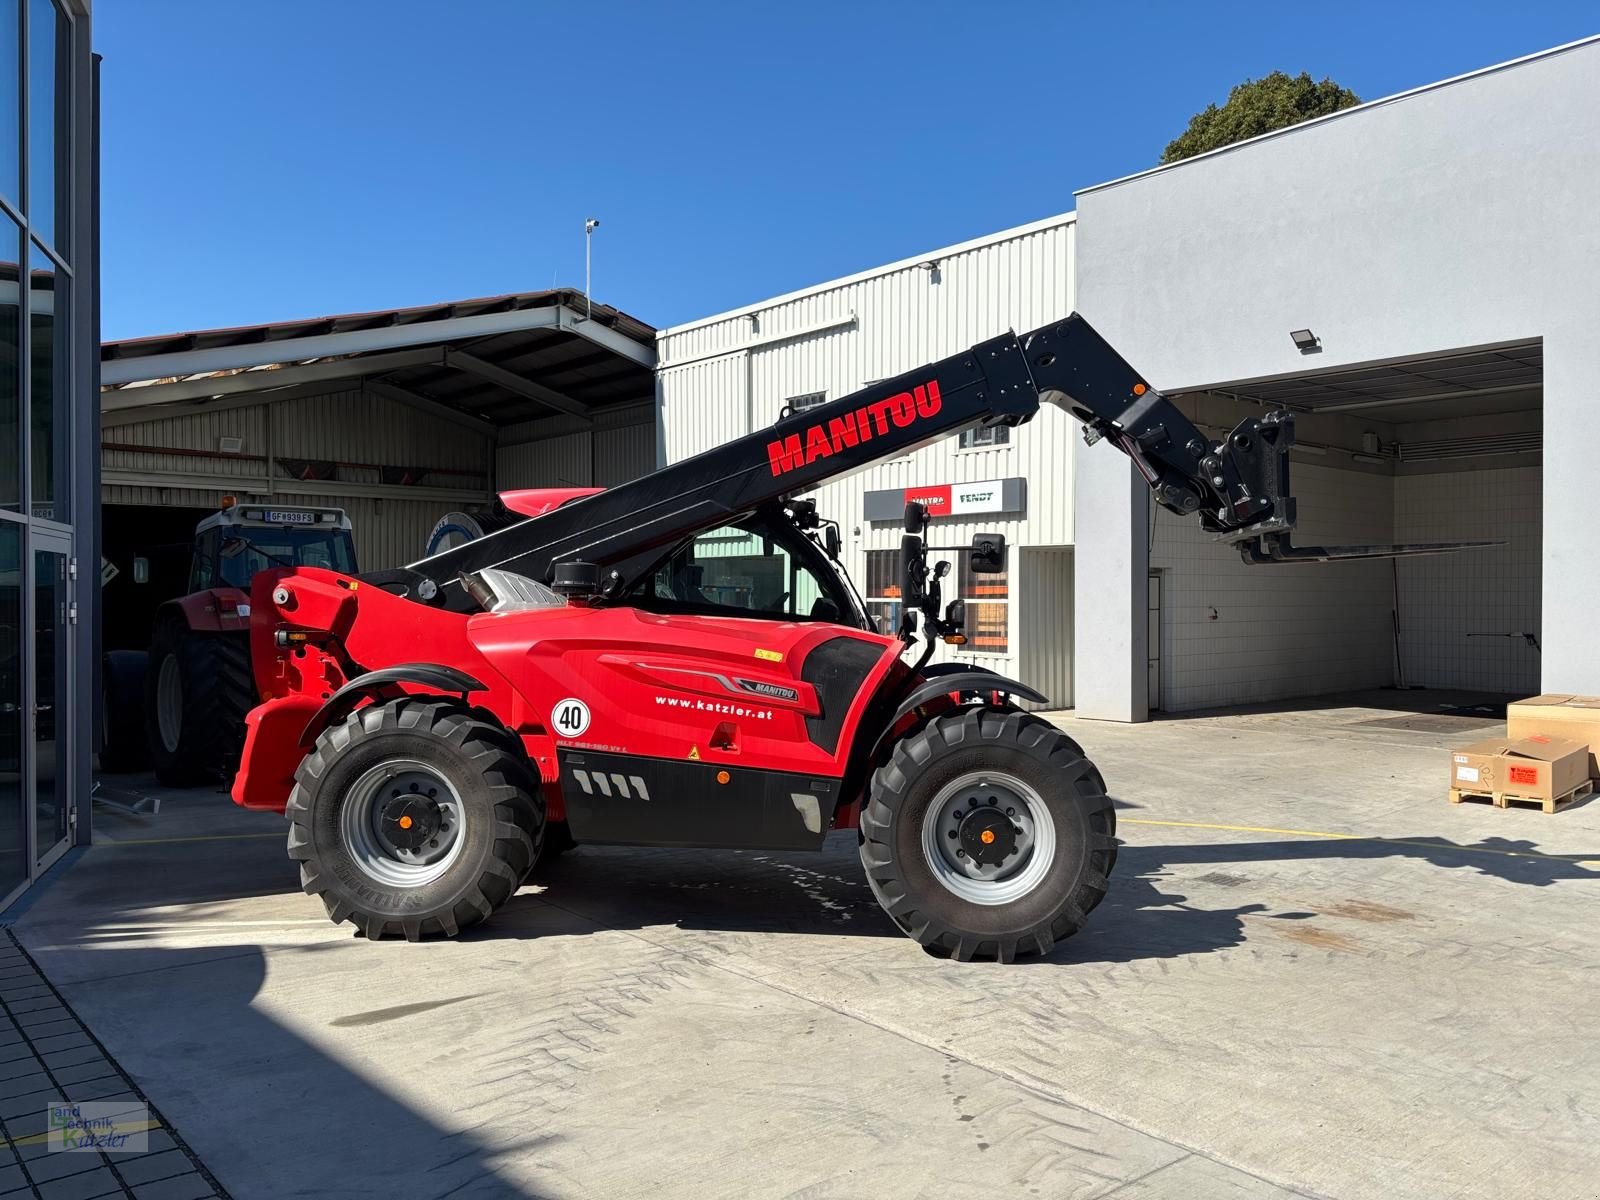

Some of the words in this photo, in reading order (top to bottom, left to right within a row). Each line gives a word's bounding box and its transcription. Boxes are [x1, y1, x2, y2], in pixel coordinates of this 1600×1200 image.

[767, 380, 942, 477] MANITOU
[960, 491, 994, 503] FENDT
[755, 683, 794, 697] MANITOU
[559, 706, 582, 730] 40
[655, 696, 773, 720] www.katzler.at
